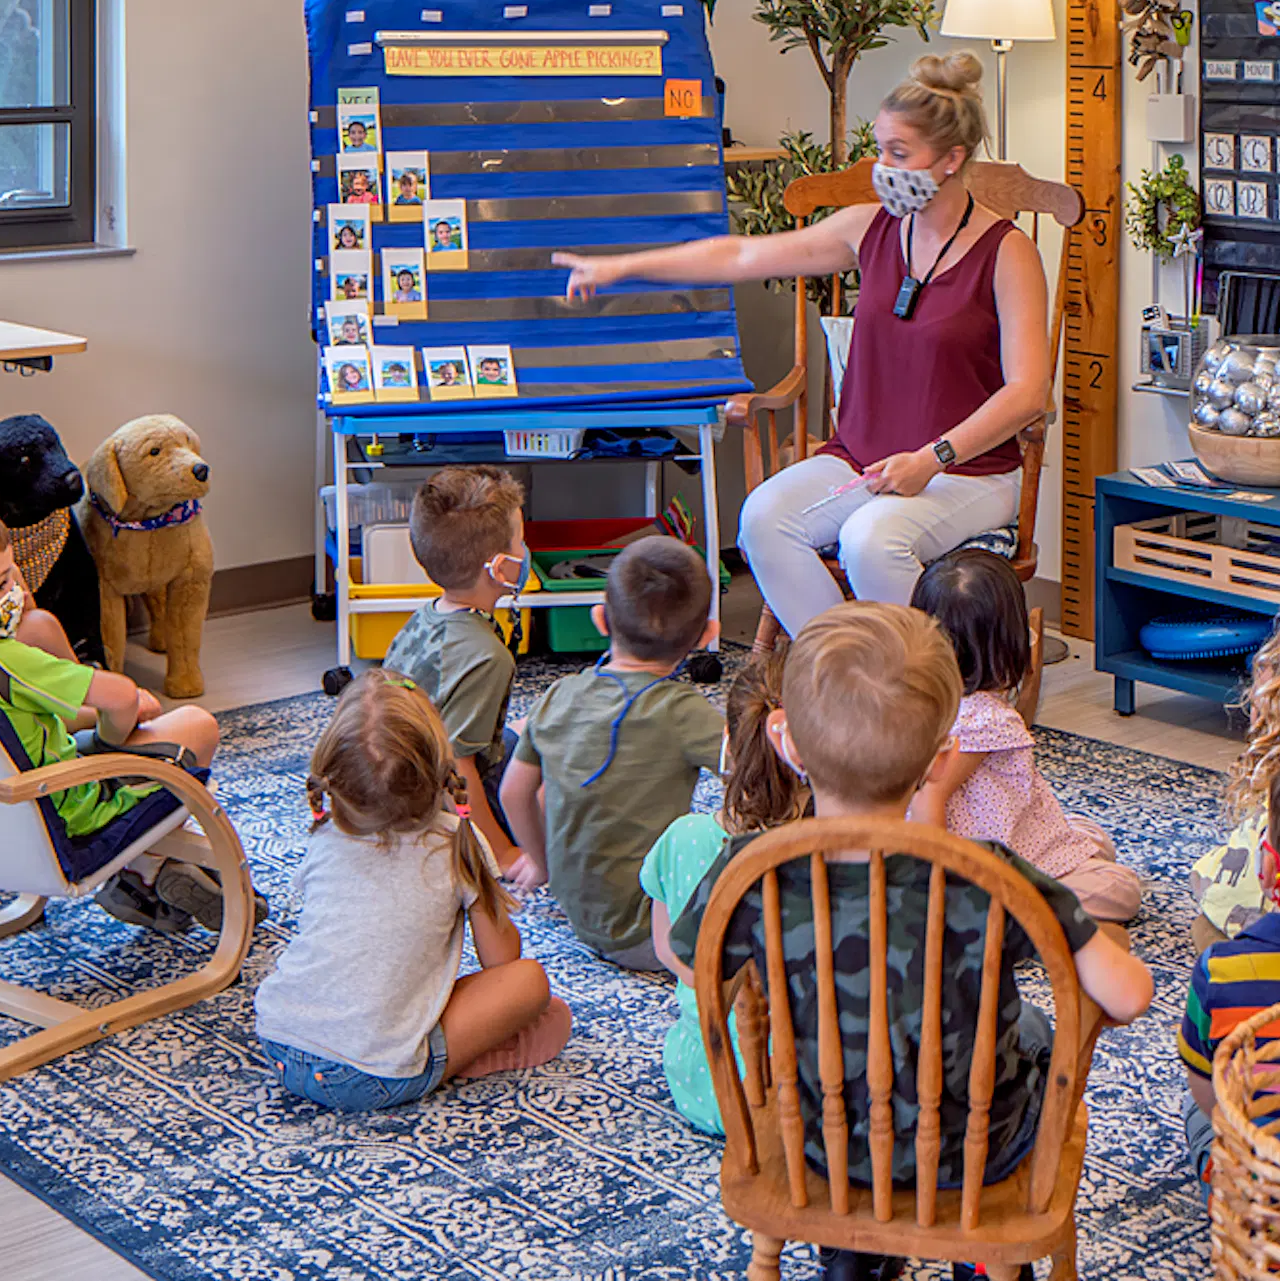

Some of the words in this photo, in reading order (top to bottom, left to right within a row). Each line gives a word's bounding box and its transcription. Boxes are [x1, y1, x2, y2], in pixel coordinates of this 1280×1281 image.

[385, 49, 422, 69] HAVE
[428, 49, 453, 68] YOU
[458, 49, 492, 68] EVER
[499, 49, 537, 69] GONE
[543, 48, 582, 69] APPLE
[586, 49, 655, 69] PICKING?
[670, 88, 694, 109] NO
[1092, 74, 1107, 101] 4
[1213, 138, 1224, 164] 5
[1092, 219, 1107, 247] 3
[1089, 361, 1104, 389] 2
